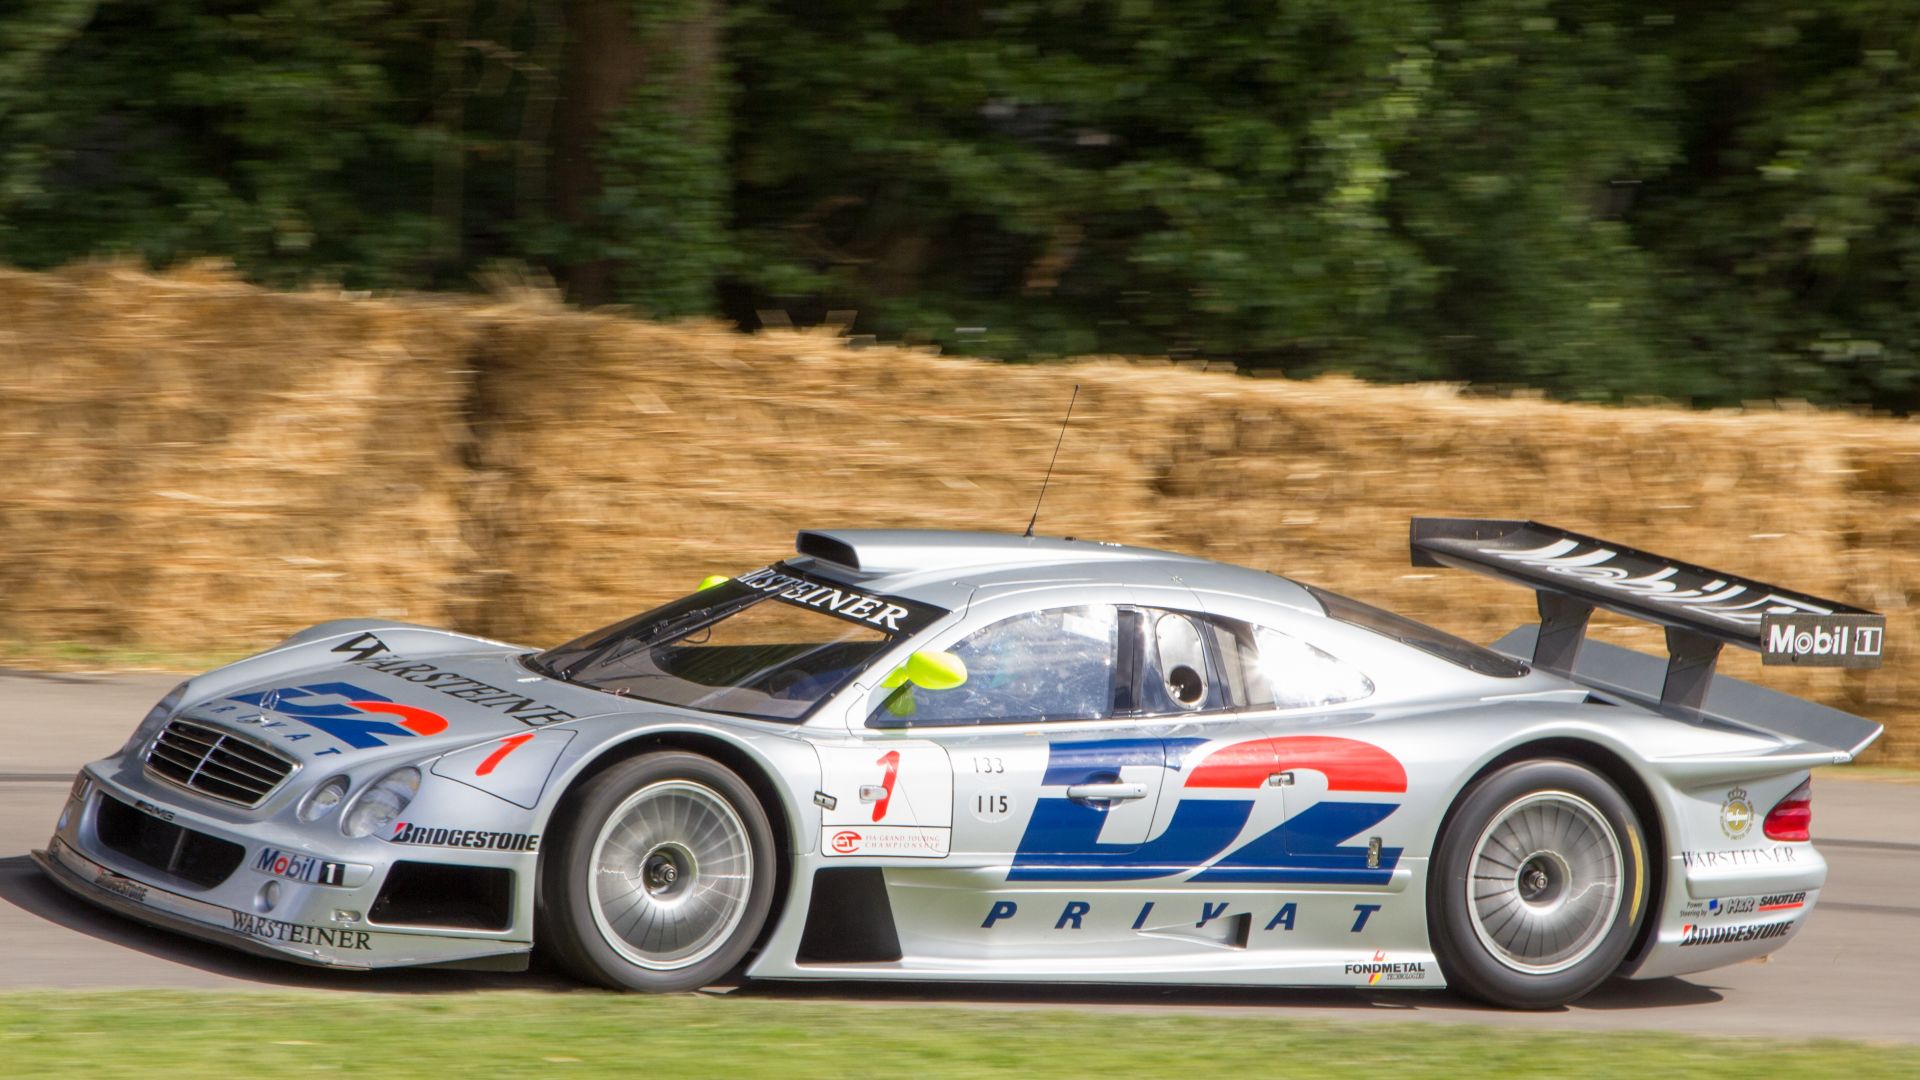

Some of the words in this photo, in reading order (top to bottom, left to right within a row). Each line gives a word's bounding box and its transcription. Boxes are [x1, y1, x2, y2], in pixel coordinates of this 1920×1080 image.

[1477, 538, 1747, 603] Mobil
[1768, 624, 1849, 655] Mobil
[223, 681, 449, 749] D2
[474, 732, 535, 776] 1
[973, 756, 1005, 774] 133
[872, 750, 901, 823] 1
[977, 795, 1008, 813] 115
[1005, 735, 1408, 885] D2
[390, 822, 540, 851] BRIDGESTONE
[879, 834, 905, 842] GRAND
[256, 847, 316, 882] Mobil
[1681, 846, 1797, 869] WARSTEINER
[231, 909, 372, 951] WARSTEINER
[980, 901, 1382, 933] PRIVAT
[1680, 920, 1796, 947] BRIDGESTONE
[1344, 962, 1426, 975] FONDMETAL
